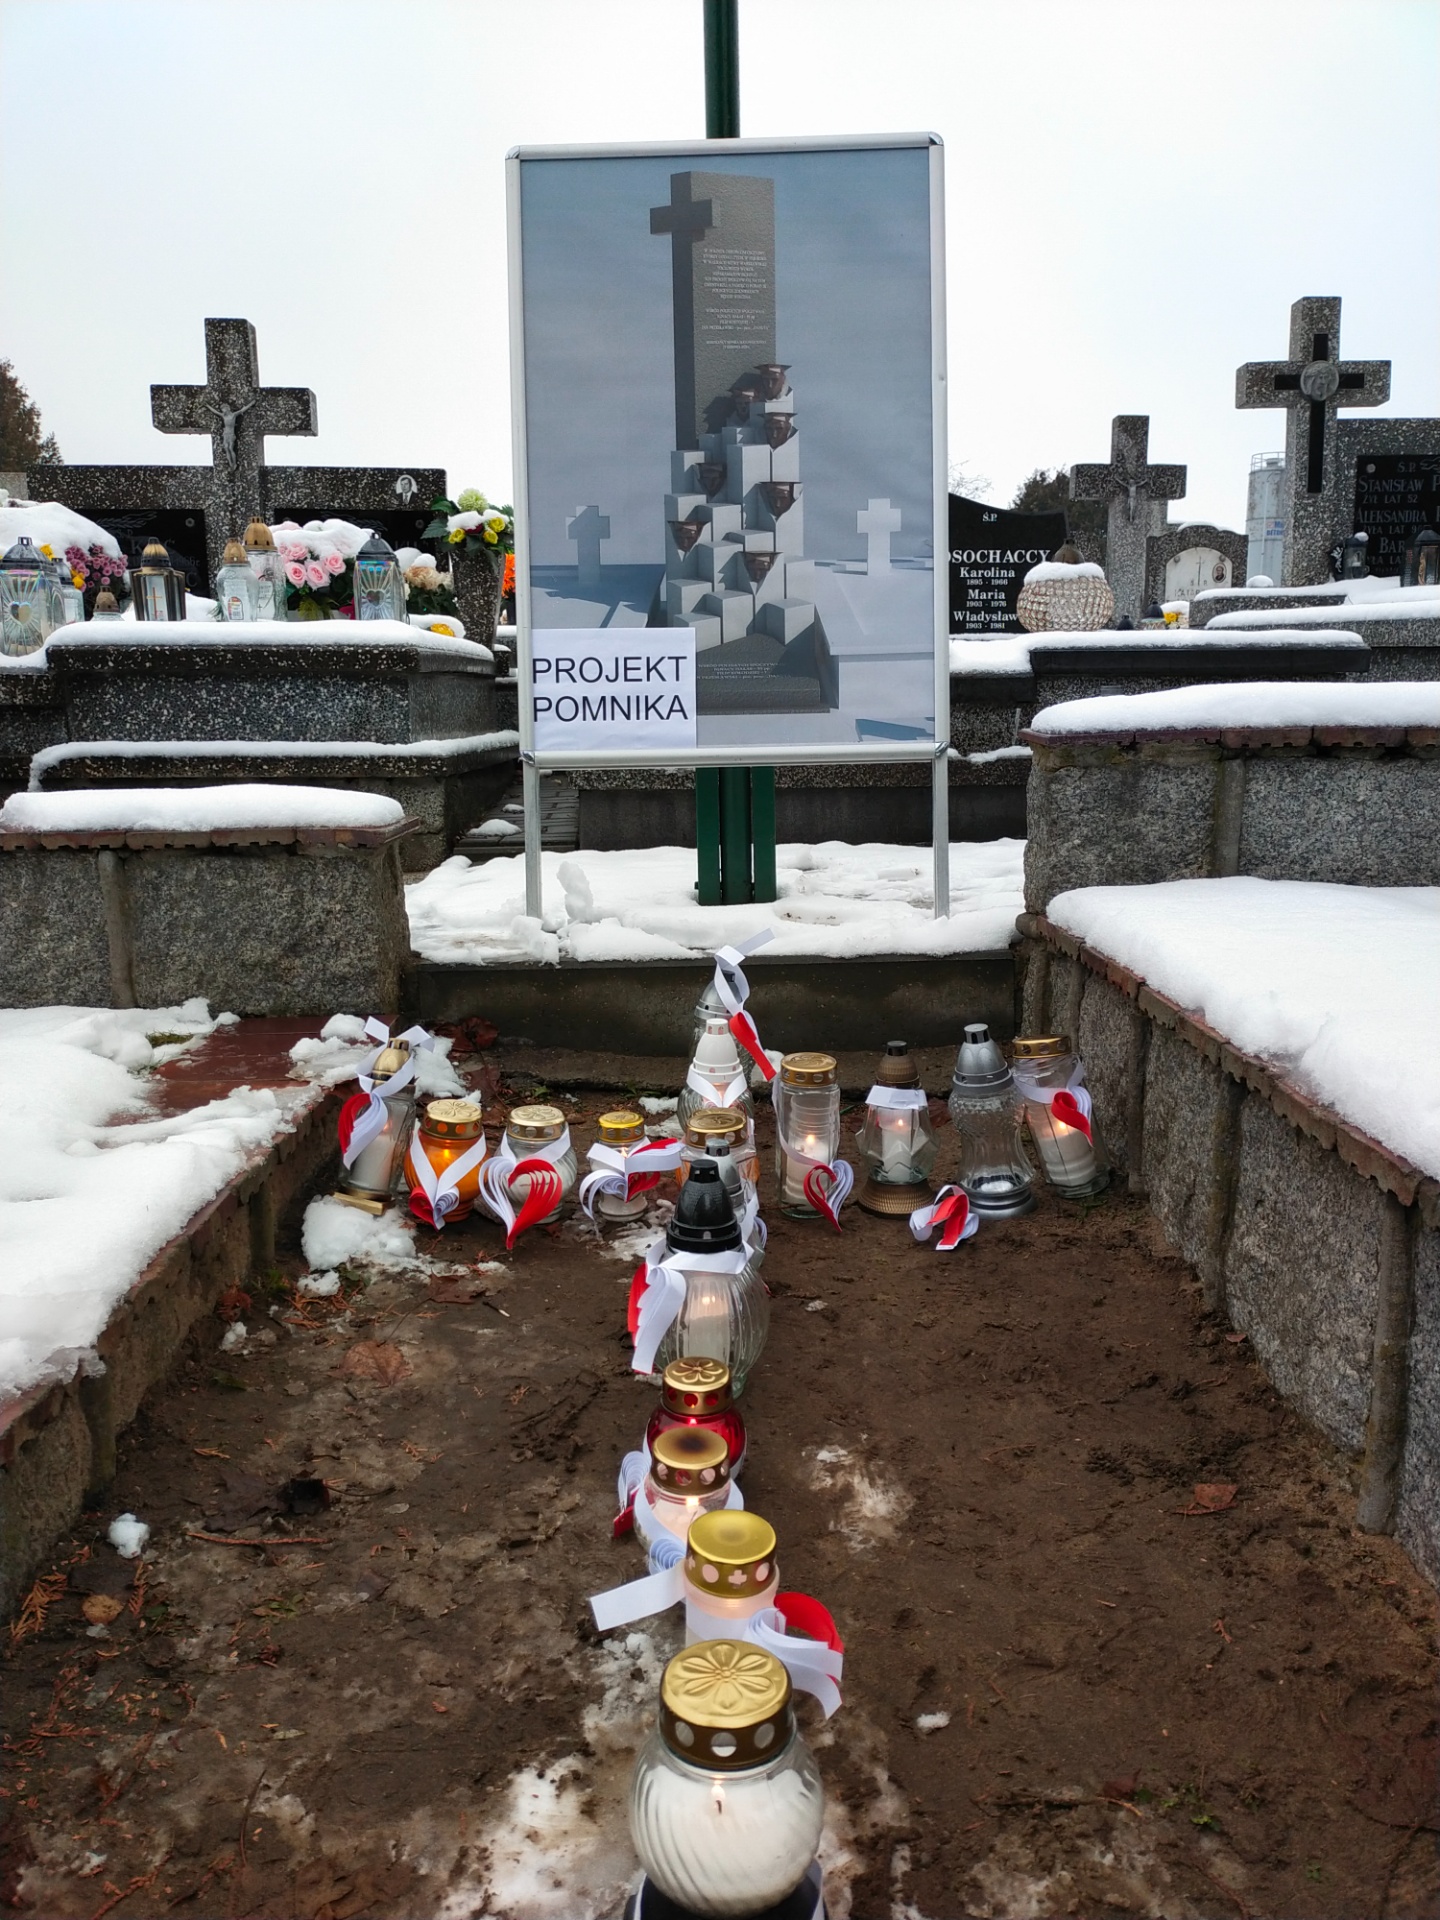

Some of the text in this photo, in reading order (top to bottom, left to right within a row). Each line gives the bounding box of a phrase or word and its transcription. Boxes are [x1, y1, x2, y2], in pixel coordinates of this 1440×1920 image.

[1384, 494, 1401, 504] LAT
[1356, 507, 1427, 524] ALEKSANDRA
[1389, 525, 1405, 534] LAT
[948, 549, 1051, 564] SOCHACCY
[959, 566, 1016, 578] Karolina
[966, 578, 983, 586] 1895
[967, 588, 1006, 600] Maria
[953, 610, 1018, 623] Władysław
[532, 656, 688, 684] PROJEKT
[533, 694, 689, 723] POMNIKA
